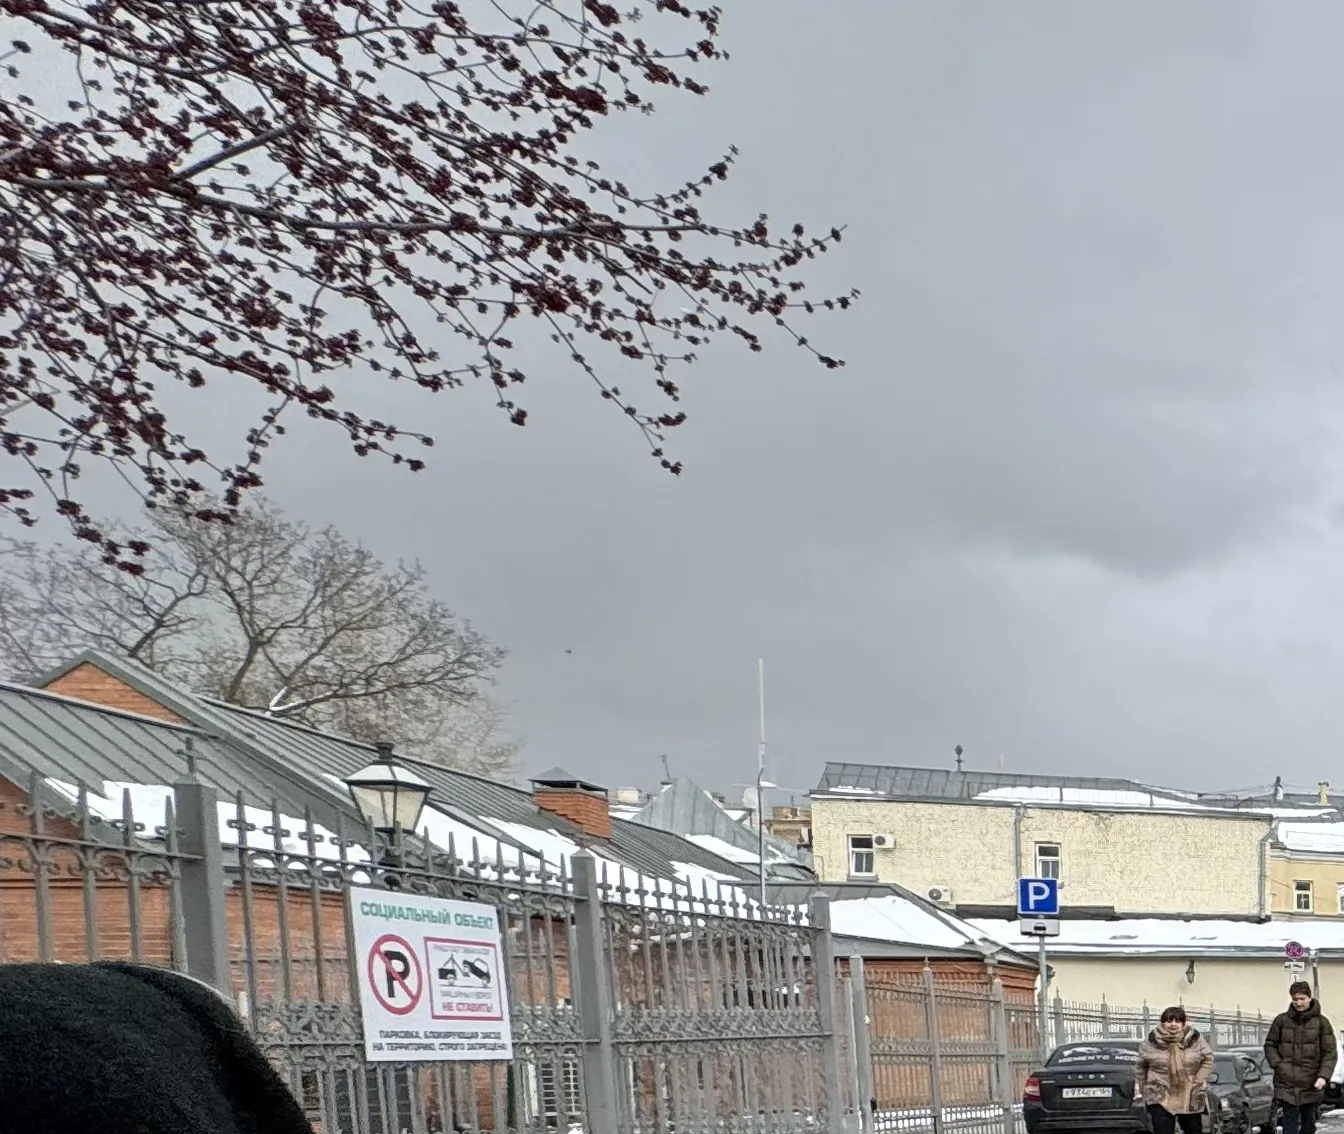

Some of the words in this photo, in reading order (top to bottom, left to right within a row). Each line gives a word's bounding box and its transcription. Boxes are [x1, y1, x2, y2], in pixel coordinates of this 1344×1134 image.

[1028, 881, 1050, 910] P
[360, 901, 451, 925] СОЦИАЛЬНЫЙ
[454, 913, 494, 930] ОБЪЕКТ
[442, 1002, 454, 1012] НЕ
[378, 1030, 422, 1040] ПАРКОВКА,
[372, 1042, 384, 1051] НА
[438, 1042, 465, 1051] СТРОГО
[1058, 1055, 1110, 1063] MEMENTO
